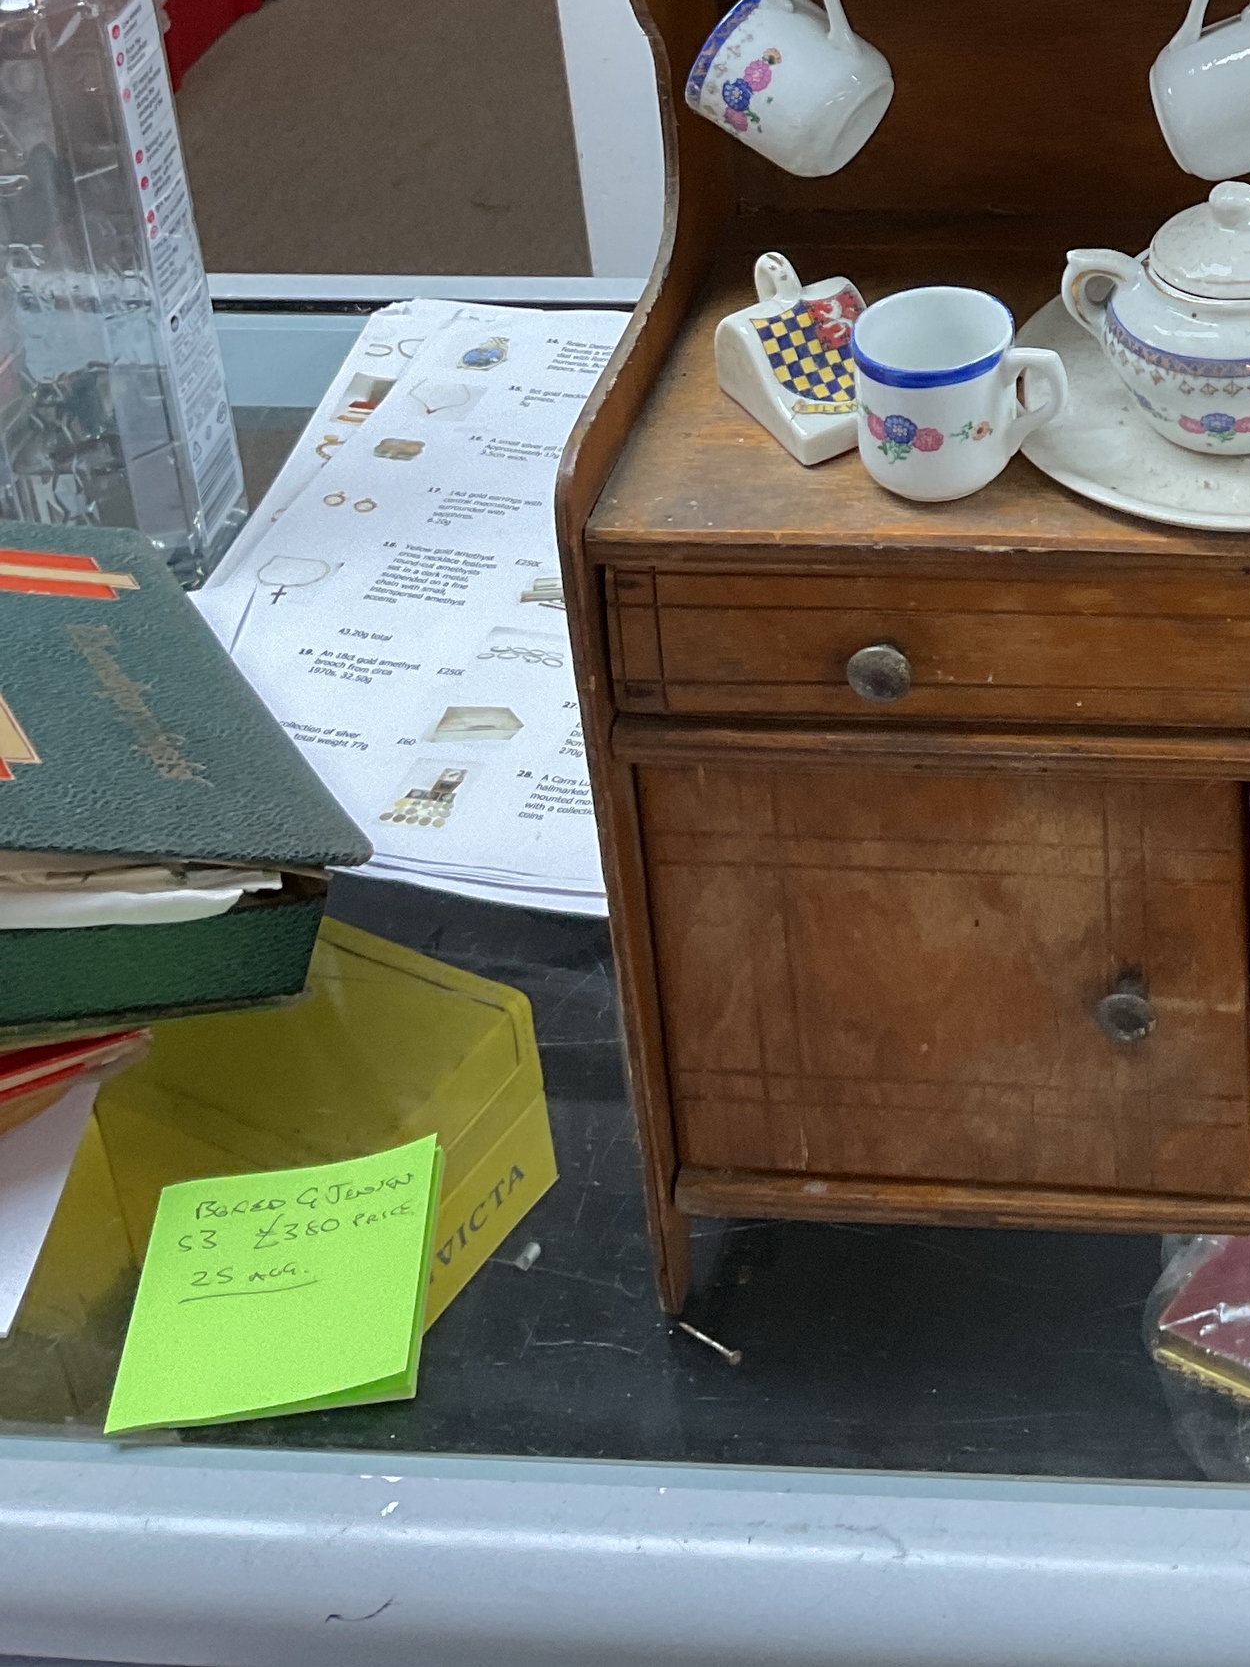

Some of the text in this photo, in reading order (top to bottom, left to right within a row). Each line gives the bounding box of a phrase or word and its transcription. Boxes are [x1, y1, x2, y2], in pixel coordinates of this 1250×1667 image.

[438, 505, 486, 513] surrounded
[473, 500, 520, 511] moonstone
[398, 551, 497, 569] cross necklace features
[455, 551, 495, 561] amethyst
[393, 558, 481, 575] round-cut amethysts
[381, 572, 429, 583] suspended
[375, 579, 399, 587] chain
[421, 587, 446, 596] small,
[363, 594, 397, 603] accents
[370, 586, 465, 606] interspersed amethyst
[338, 628, 393, 641] 43.20g total
[314, 658, 346, 669] brooch
[347, 664, 369, 673] from
[336, 652, 355, 660] 18ct
[357, 656, 378, 665] gold
[379, 659, 421, 671] amethyst
[340, 672, 373, 684] 32.50g
[562, 701, 578, 709] 27.
[335, 730, 361, 739] silver
[294, 734, 369, 750] total weight 77g
[396, 738, 416, 746] £60
[559, 747, 583, 757] 270g
[517, 770, 533, 779] 28.
[552, 776, 578, 785] Carrs
[536, 783, 589, 796] hallmarked
[530, 793, 574, 804] mounted
[525, 802, 545, 810] with
[518, 811, 544, 820] coins
[352, 1199, 414, 1227] PRICE
